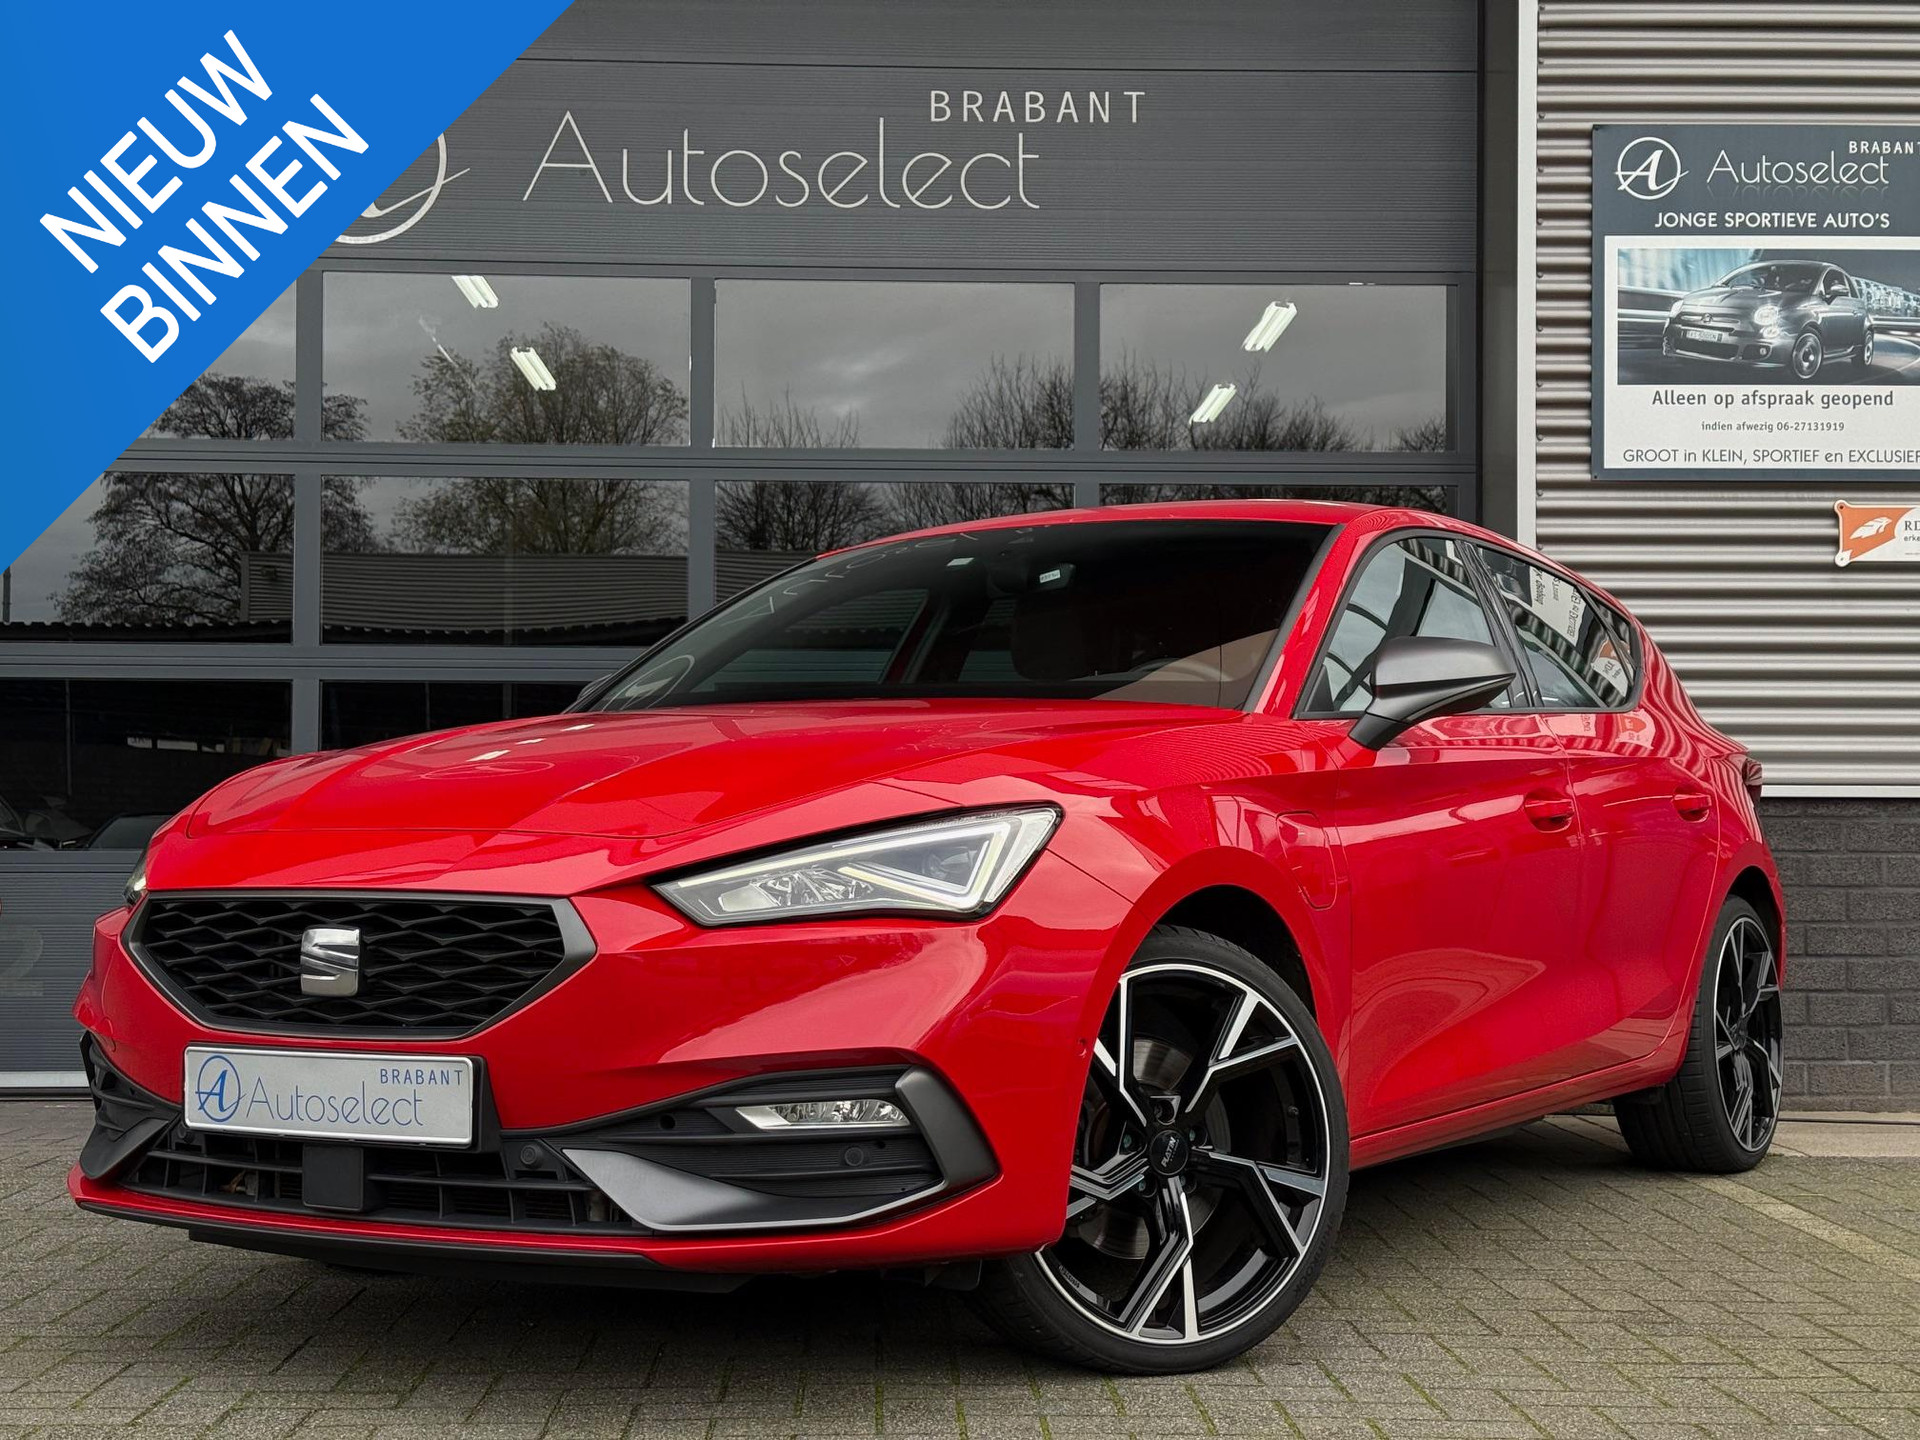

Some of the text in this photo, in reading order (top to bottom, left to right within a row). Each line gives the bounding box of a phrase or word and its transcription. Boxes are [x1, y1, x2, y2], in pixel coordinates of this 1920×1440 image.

[930, 90, 1146, 123] BRABANT
[522, 110, 1041, 209] Autoselect
[1706, 150, 1890, 184] Autoselect
[1654, 212, 1890, 229] JONGE SPORTIEVE AUTO'S
[1652, 389, 1894, 410] Alleen op afspraak geopend
[1701, 421, 1845, 433] indien afwezig 06-27131919
[1623, 449, 1920, 465] GROOT in KLEIN, SPORTIEF en EXCLUSIEF
[380, 1068, 463, 1086] BRABANT
[246, 1076, 424, 1126] Autoselect
[1160, 1135, 1177, 1168] PLATIN
